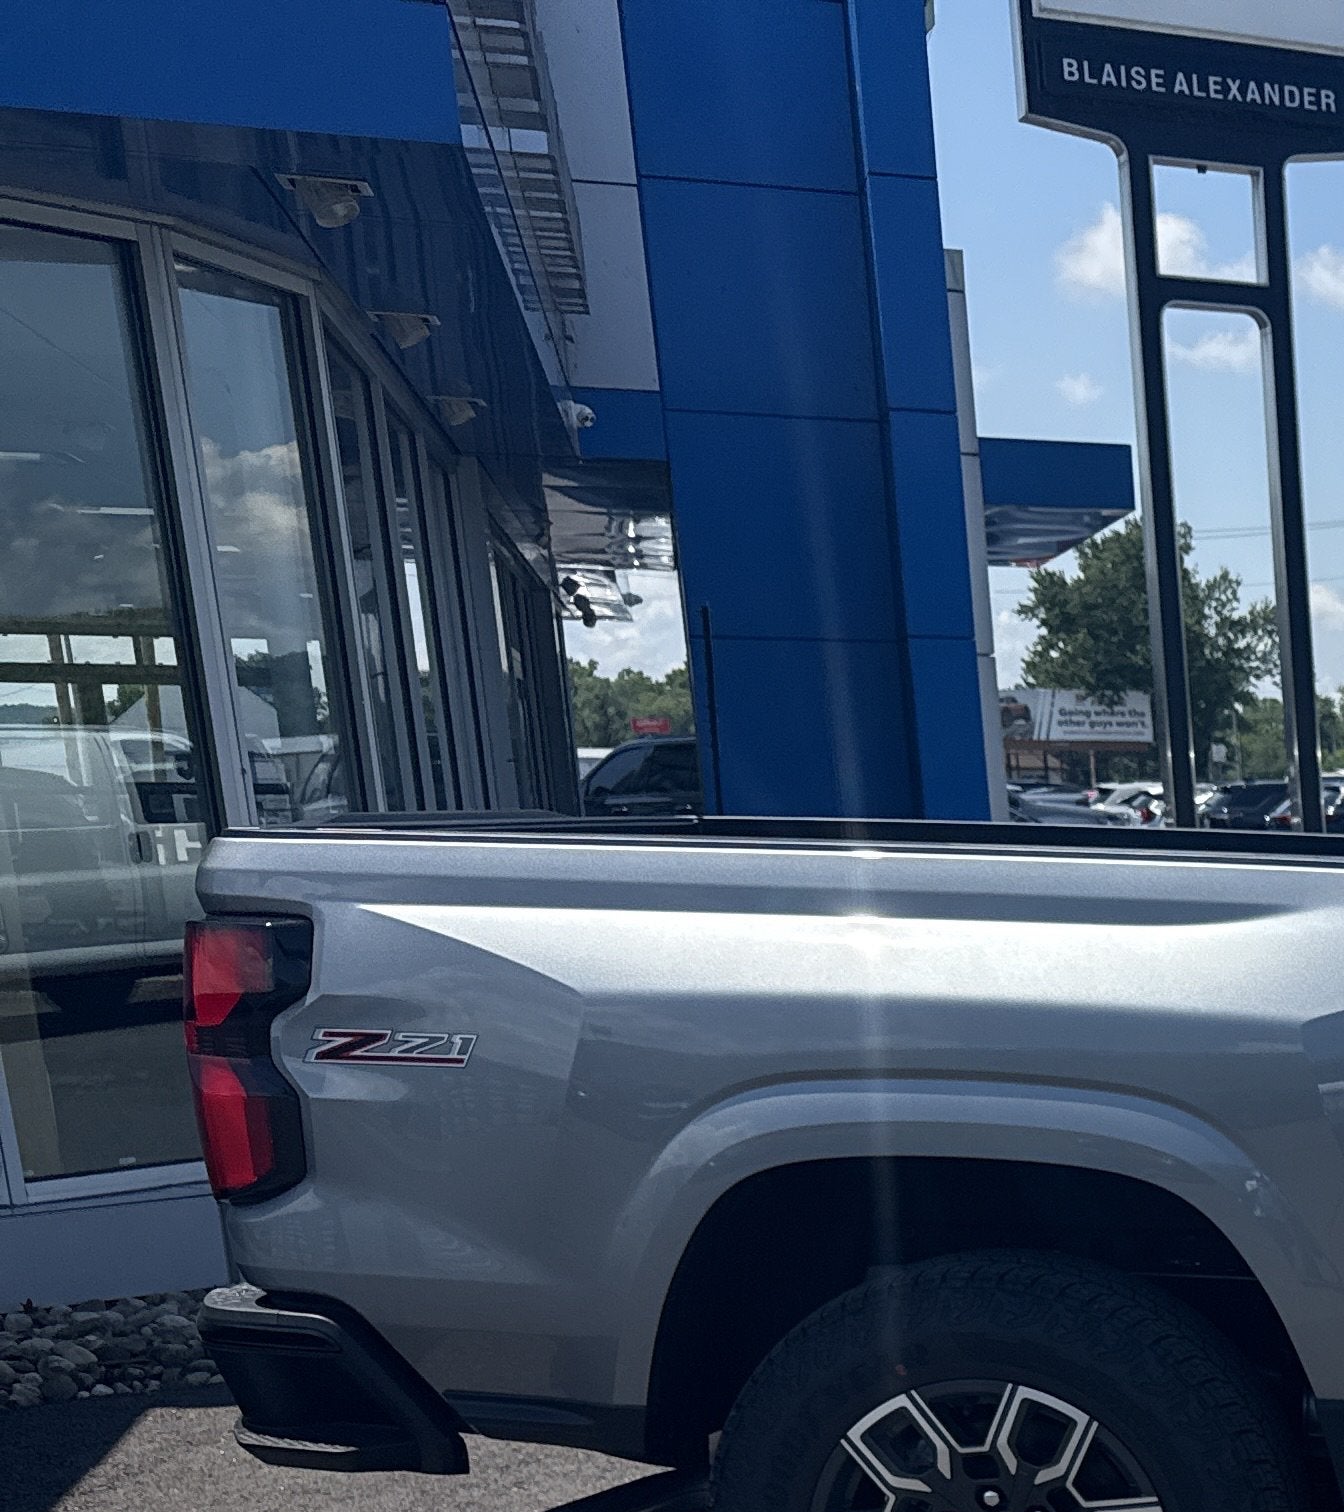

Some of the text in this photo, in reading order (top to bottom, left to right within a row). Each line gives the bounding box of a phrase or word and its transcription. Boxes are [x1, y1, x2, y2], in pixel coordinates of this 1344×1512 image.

[1062, 57, 1337, 113] BLAISE ALEXANDER
[303, 1027, 479, 1069] Z71
